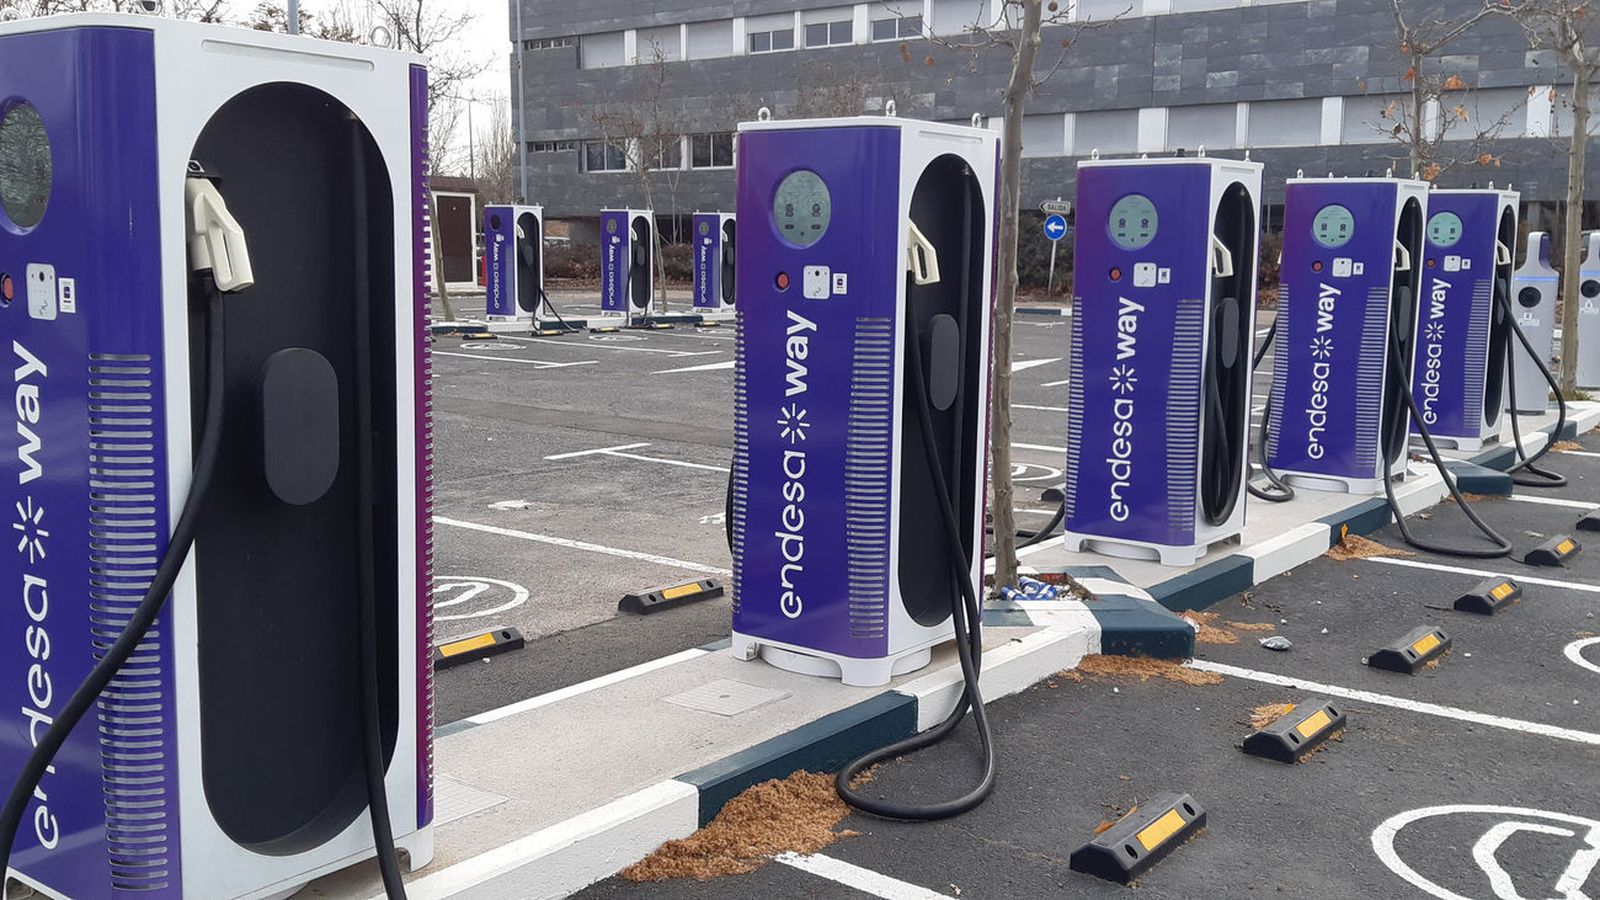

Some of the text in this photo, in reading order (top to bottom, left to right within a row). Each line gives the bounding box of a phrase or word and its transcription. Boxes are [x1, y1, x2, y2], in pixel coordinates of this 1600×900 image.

[12, 340, 48, 485] way
[1106, 296, 1145, 522] endesa way
[1305, 282, 1342, 459] endesa way
[1421, 277, 1452, 425] endesa way
[774, 309, 817, 619] endesa way
